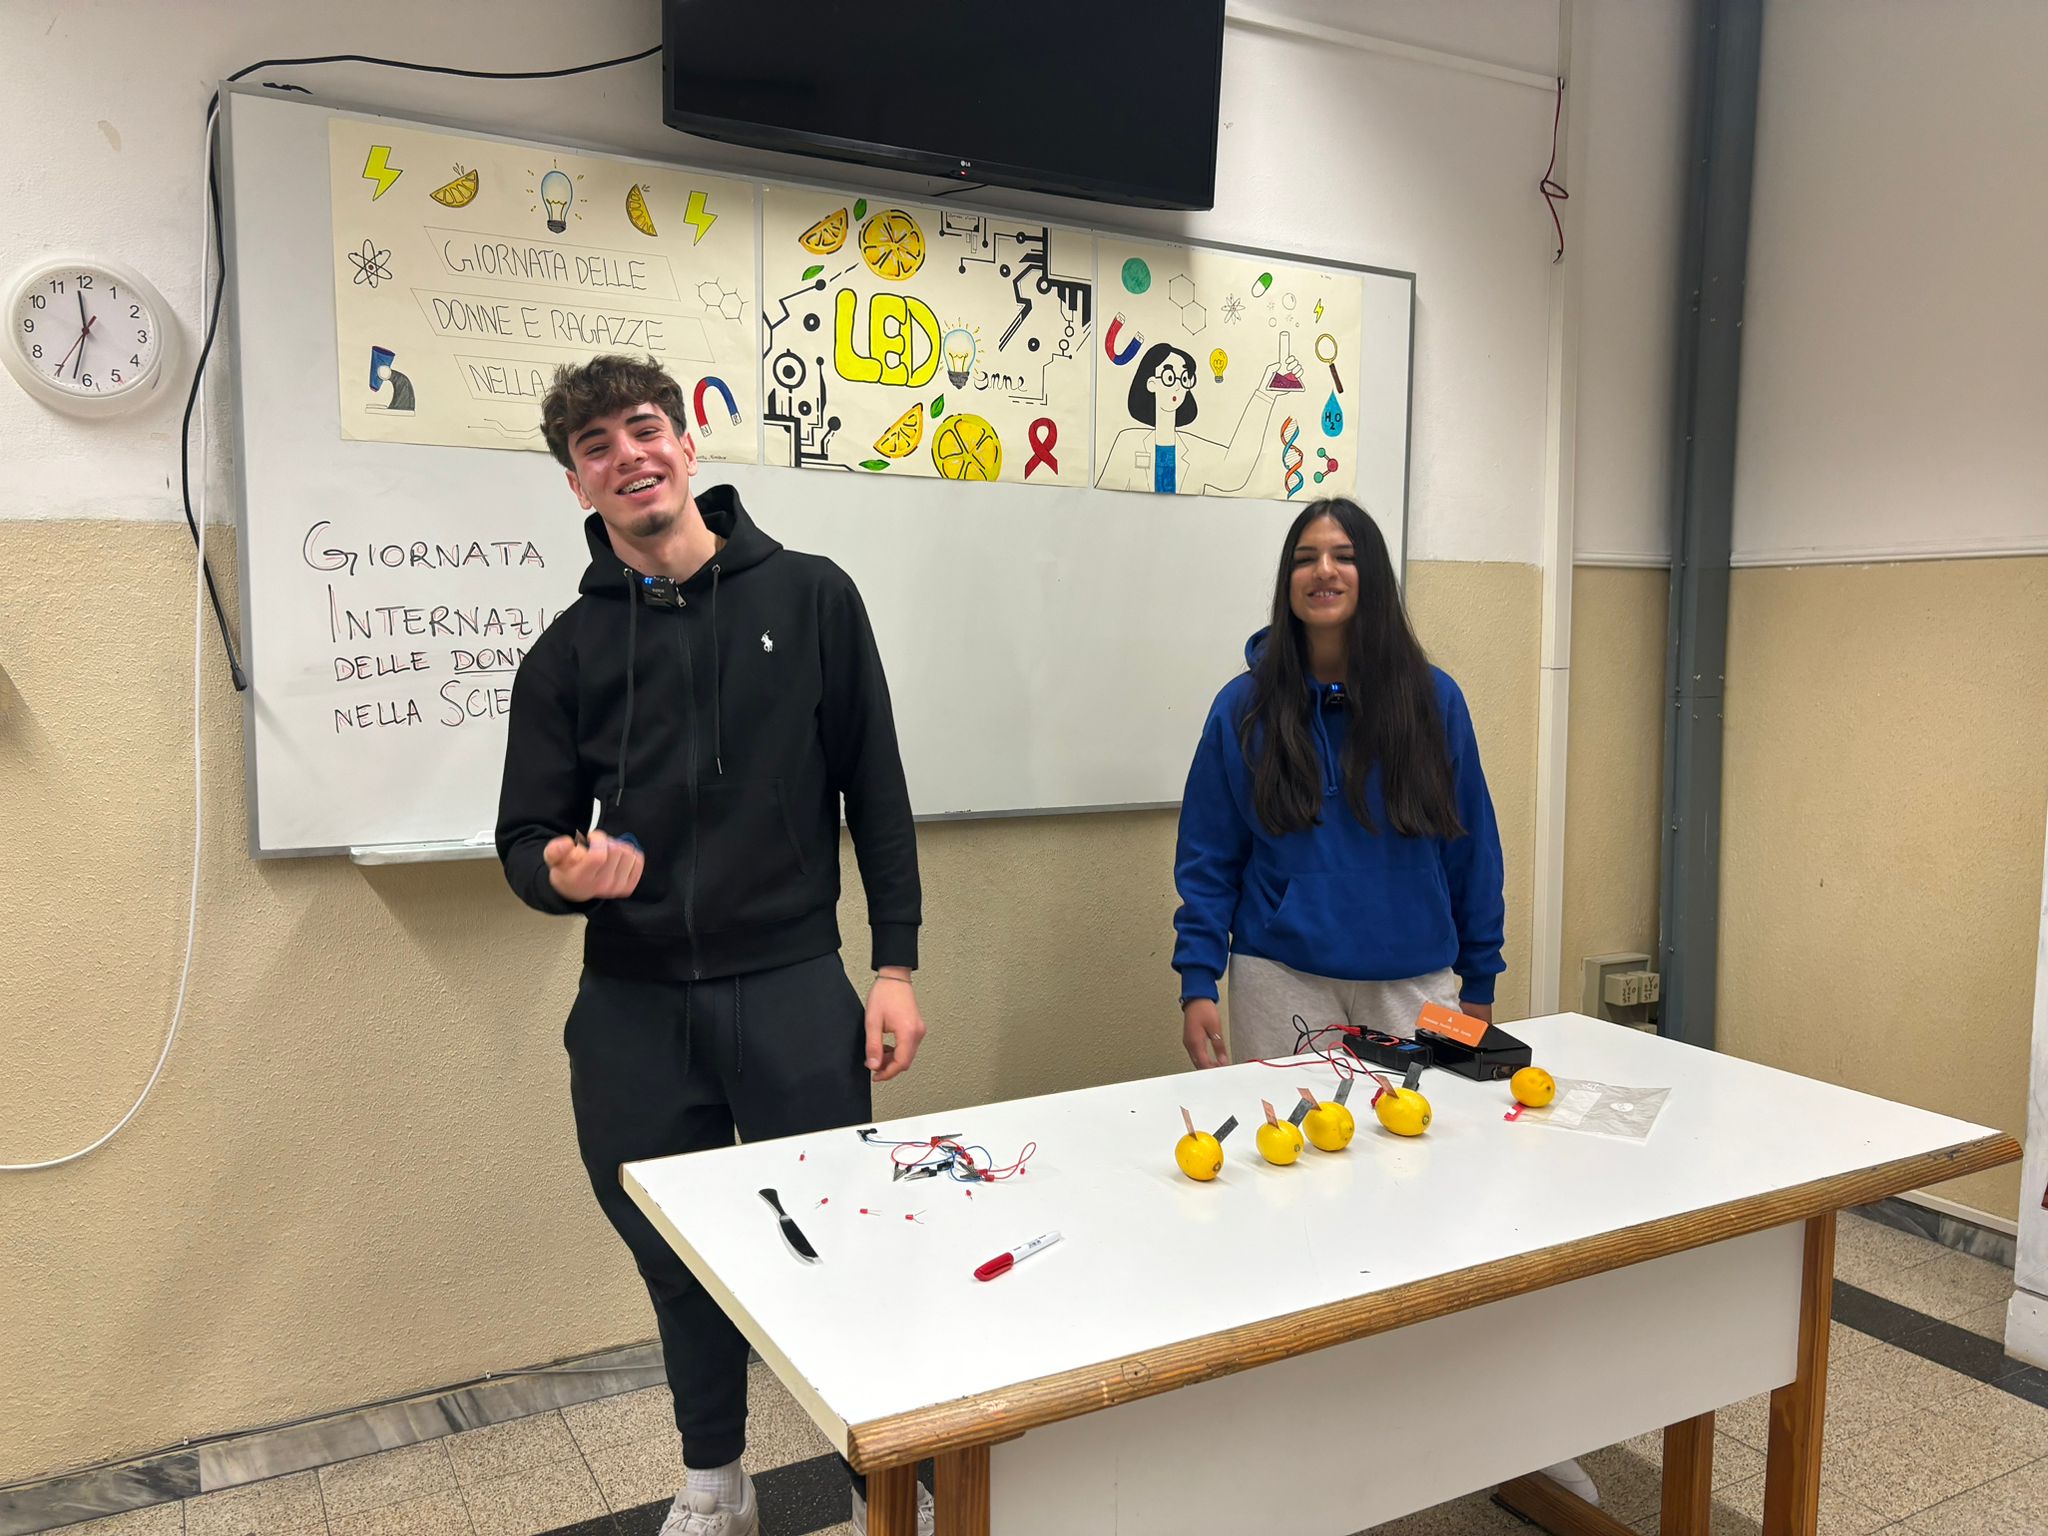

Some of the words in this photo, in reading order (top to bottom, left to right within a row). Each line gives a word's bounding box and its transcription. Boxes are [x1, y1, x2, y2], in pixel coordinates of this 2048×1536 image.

[444, 240, 569, 282] GIORNATA
[576, 256, 647, 290] DELLE
[50, 280, 64, 294] 11
[76, 275, 93, 289] 12
[109, 286, 117, 299] 1
[29, 295, 46, 309] 10
[129, 305, 140, 319] 2
[24, 319, 34, 333] 9
[433, 298, 513, 336] DONNE
[521, 307, 541, 338] E
[551, 309, 666, 351] RAGAZZE
[137, 330, 147, 344] 3
[834, 288, 941, 387] LED
[32, 345, 43, 358] 8
[130, 354, 140, 367] 4
[55, 363, 64, 377] 7
[111, 369, 121, 383] 5
[82, 374, 92, 387] 6
[468, 364, 547, 397] NELLA
[303, 521, 545, 576] GIORNATA
[327, 584, 565, 643] INTERNAZI
[334, 651, 430, 682] DELLE
[334, 699, 422, 733] NELLA
